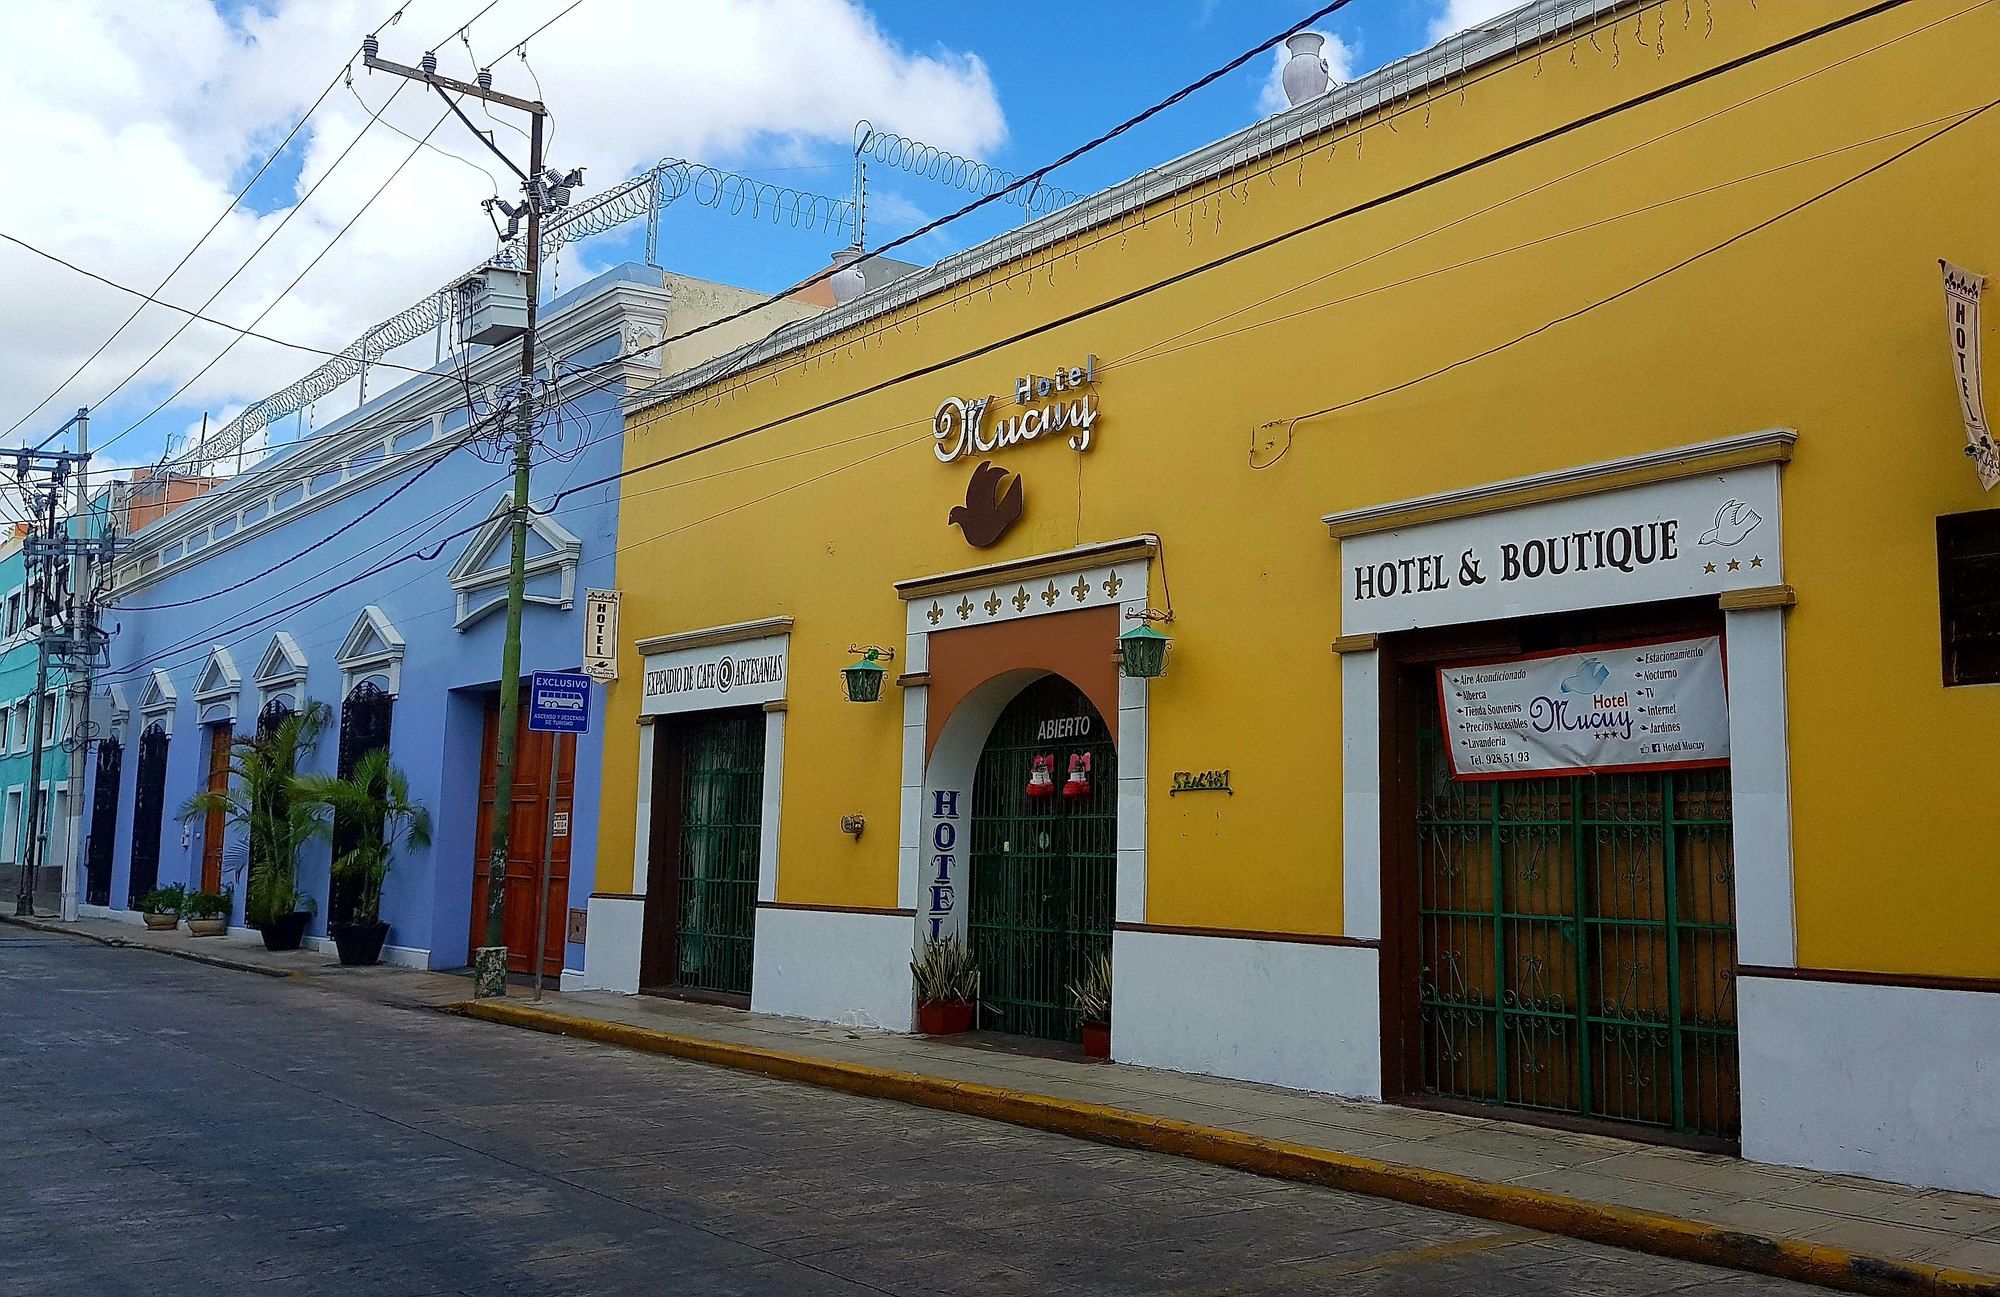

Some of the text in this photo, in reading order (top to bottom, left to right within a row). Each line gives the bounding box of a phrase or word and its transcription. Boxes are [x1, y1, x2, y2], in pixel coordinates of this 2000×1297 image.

[1954, 302, 1978, 422] HOTEL
[1015, 353, 1097, 405] Hotel
[933, 394, 1099, 463] Mucuy
[1355, 519, 1679, 601] HOTEL & BOUTIQUE
[596, 603, 607, 655] HOTEL
[1645, 646, 1704, 664] Estacionamiento
[536, 677, 588, 689] EXCLUSIVO
[646, 667, 683, 697] EXPENDIO
[683, 665, 694, 692] DE
[696, 663, 716, 690] CAFE
[734, 655, 783, 686] ARTESANIAS
[1460, 669, 1527, 685] Aire Acondicionado
[1644, 669, 1678, 681] Nocturno
[1463, 690, 1487, 701] Alberca
[1593, 691, 1629, 710] Hotel
[1645, 687, 1655, 699] TV
[1464, 702, 1522, 717] Tienda Souvenirs
[1647, 703, 1677, 716] Internet
[1466, 718, 1529, 733] Precios Accesibles
[1529, 696, 1634, 740] Mucuy
[1037, 716, 1091, 740] ABIERTO
[1650, 721, 1681, 734] Jardines
[1662, 742, 1681, 753] Hotel
[1470, 751, 1530, 766] Tel. 928 51 93
